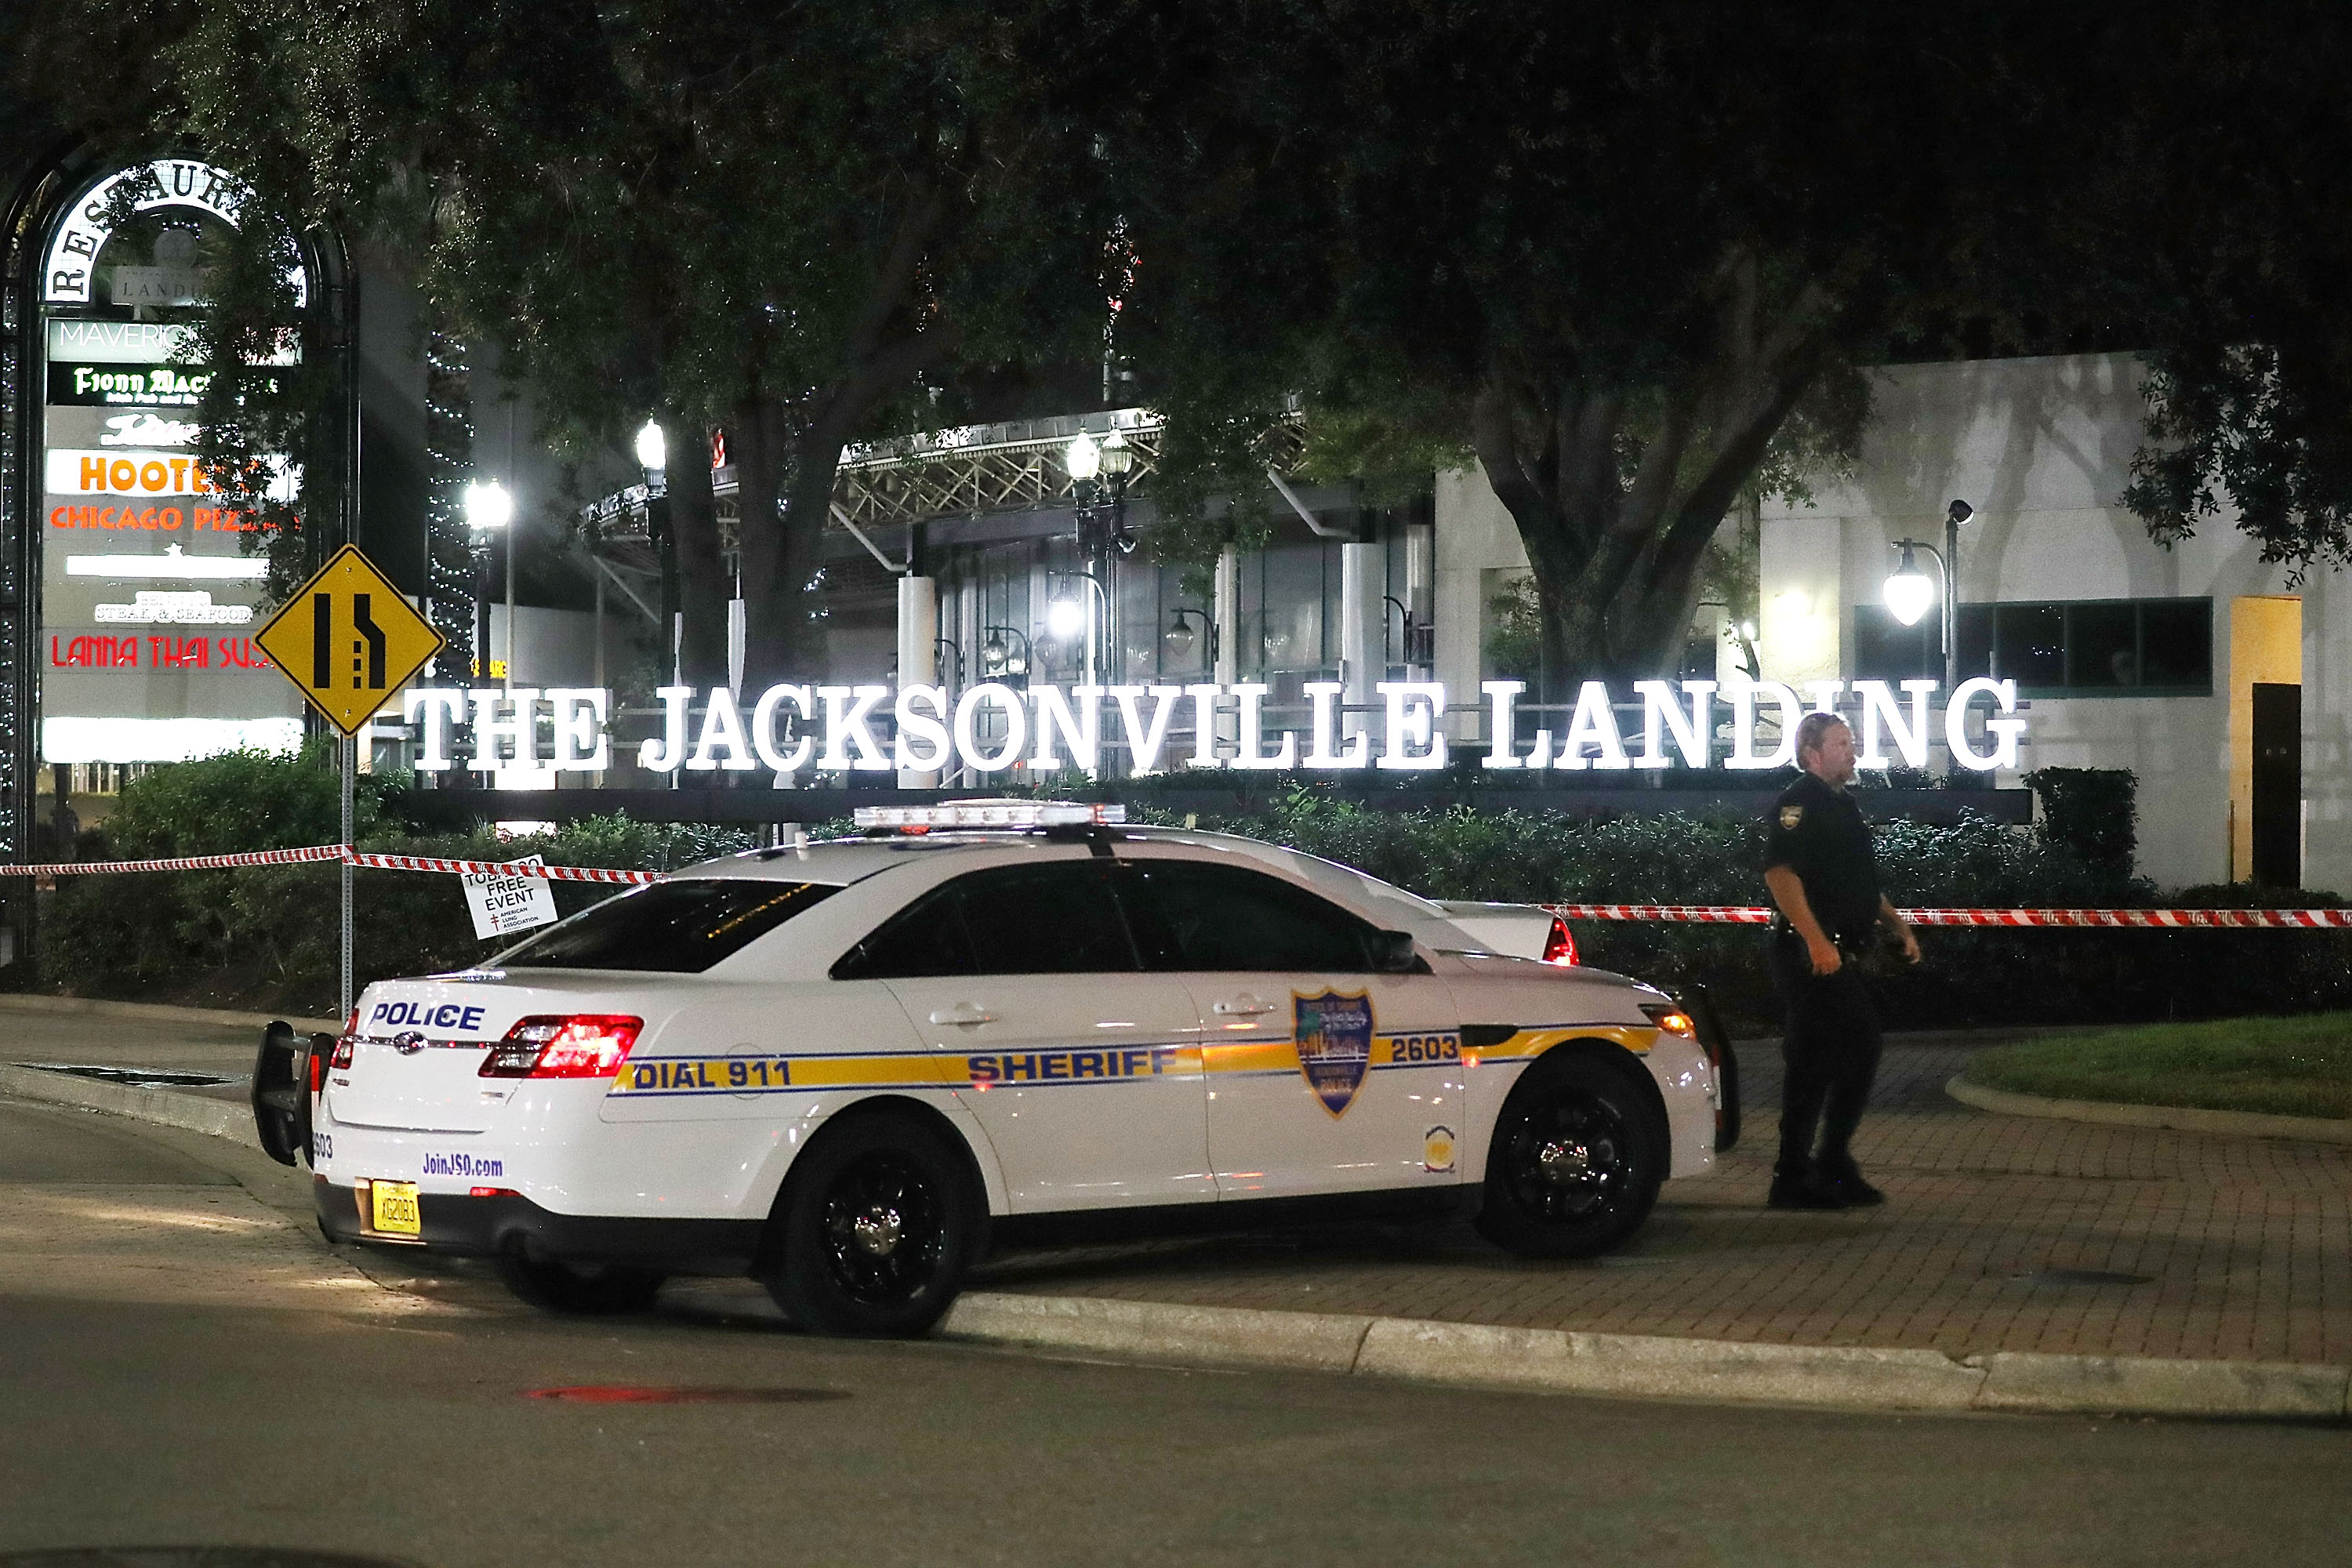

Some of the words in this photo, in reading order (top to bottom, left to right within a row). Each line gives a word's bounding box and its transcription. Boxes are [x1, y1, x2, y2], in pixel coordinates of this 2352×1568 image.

[50, 506, 183, 531] CHICAGO
[96, 608, 151, 619] STEAK
[159, 608, 170, 619] &
[176, 608, 251, 620] SEAFOOD
[53, 635, 137, 667] LANNA
[147, 636, 209, 669] THAI
[404, 687, 608, 771] THE
[640, 682, 1447, 773] JACKSONVILLE
[487, 876, 527, 896] FREE
[485, 887, 535, 911] EVENT
[500, 906, 528, 917] AMERICAN
[502, 915, 517, 924] LUNG
[503, 916, 539, 928] ASSOCIATION
[368, 1002, 485, 1031] POLICE
[1392, 1036, 1458, 1062] 2603
[634, 1062, 716, 1089] DIAL
[728, 1060, 791, 1087] 911
[967, 1049, 1176, 1082] SHERIFF
[314, 1132, 332, 1159] 603
[423, 1152, 503, 1177] JoinJSO.com
